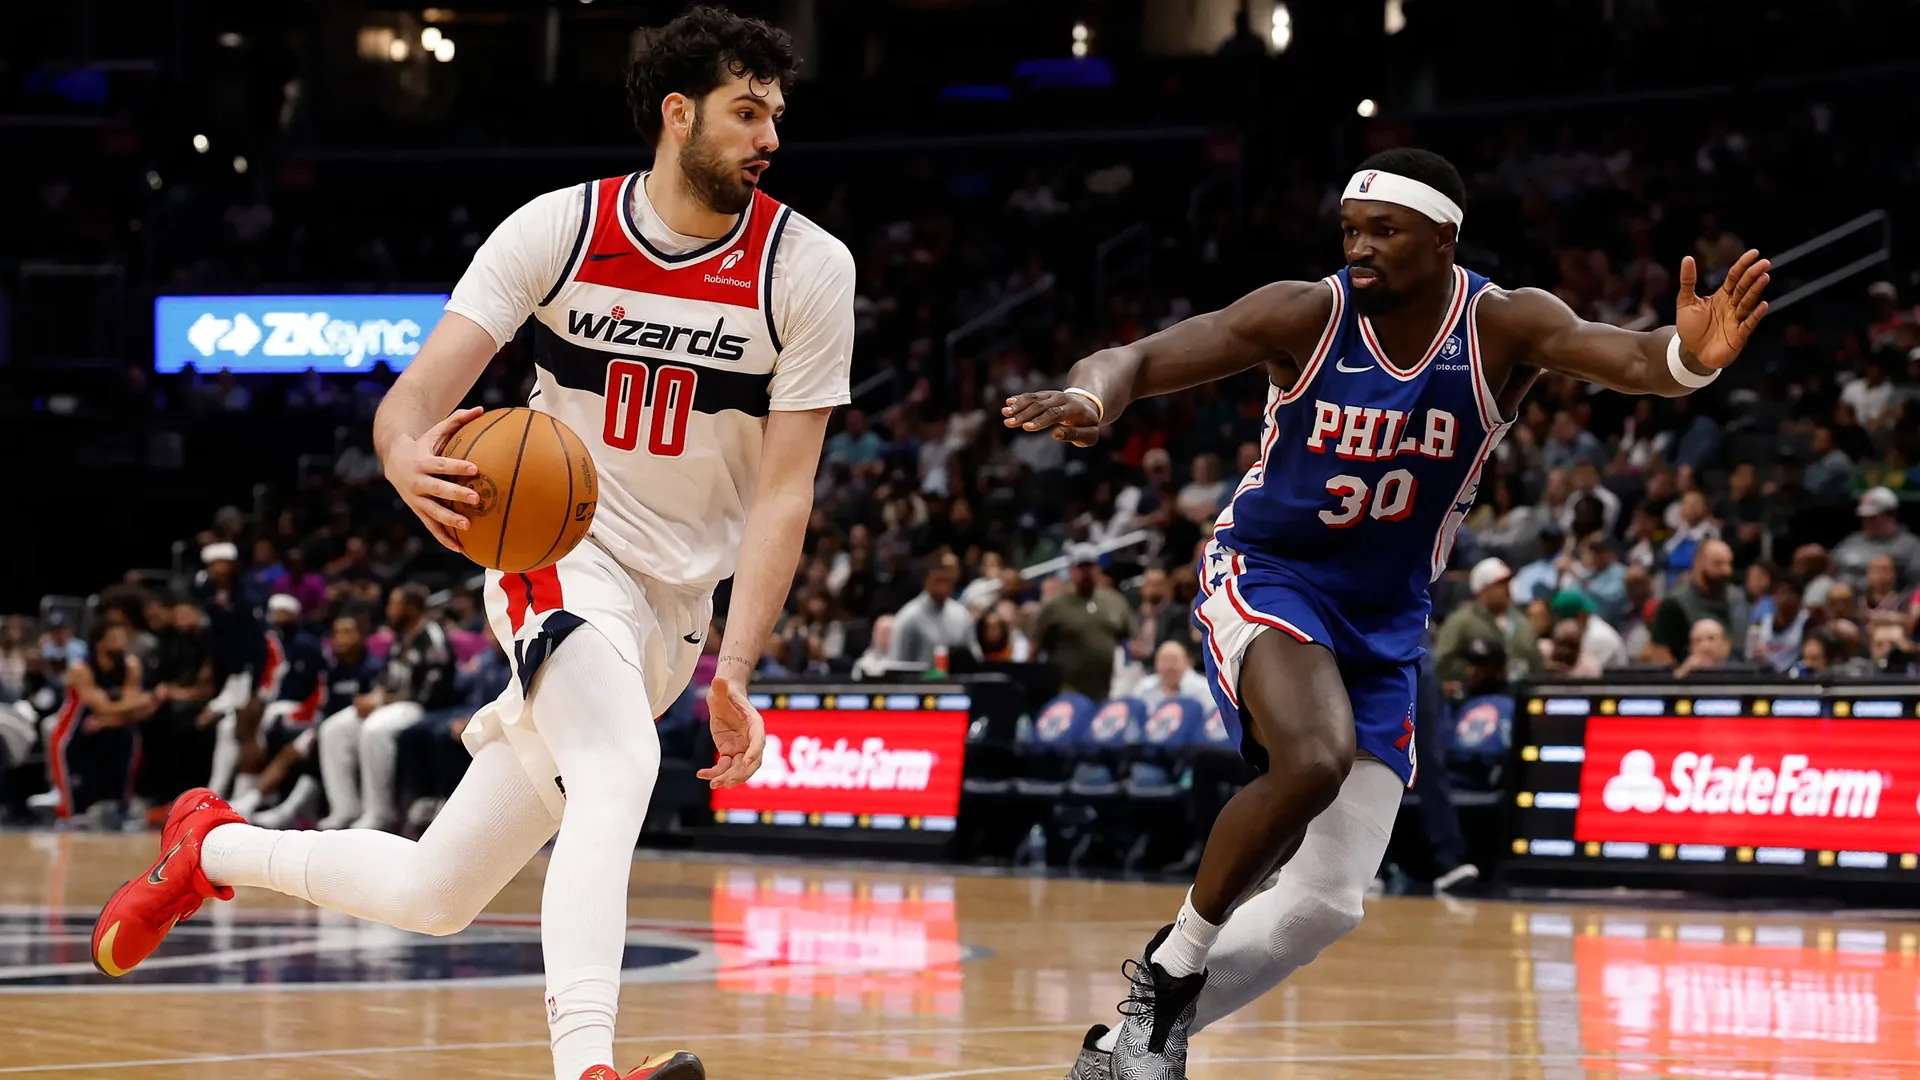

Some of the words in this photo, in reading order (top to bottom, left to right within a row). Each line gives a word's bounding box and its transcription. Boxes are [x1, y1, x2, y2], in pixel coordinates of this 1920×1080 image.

[703, 274, 752, 289] Robinhood
[1434, 363, 1469, 371] pto.com
[603, 359, 698, 458] 00
[1307, 399, 1459, 462] PHILA
[1318, 468, 1419, 529] 30
